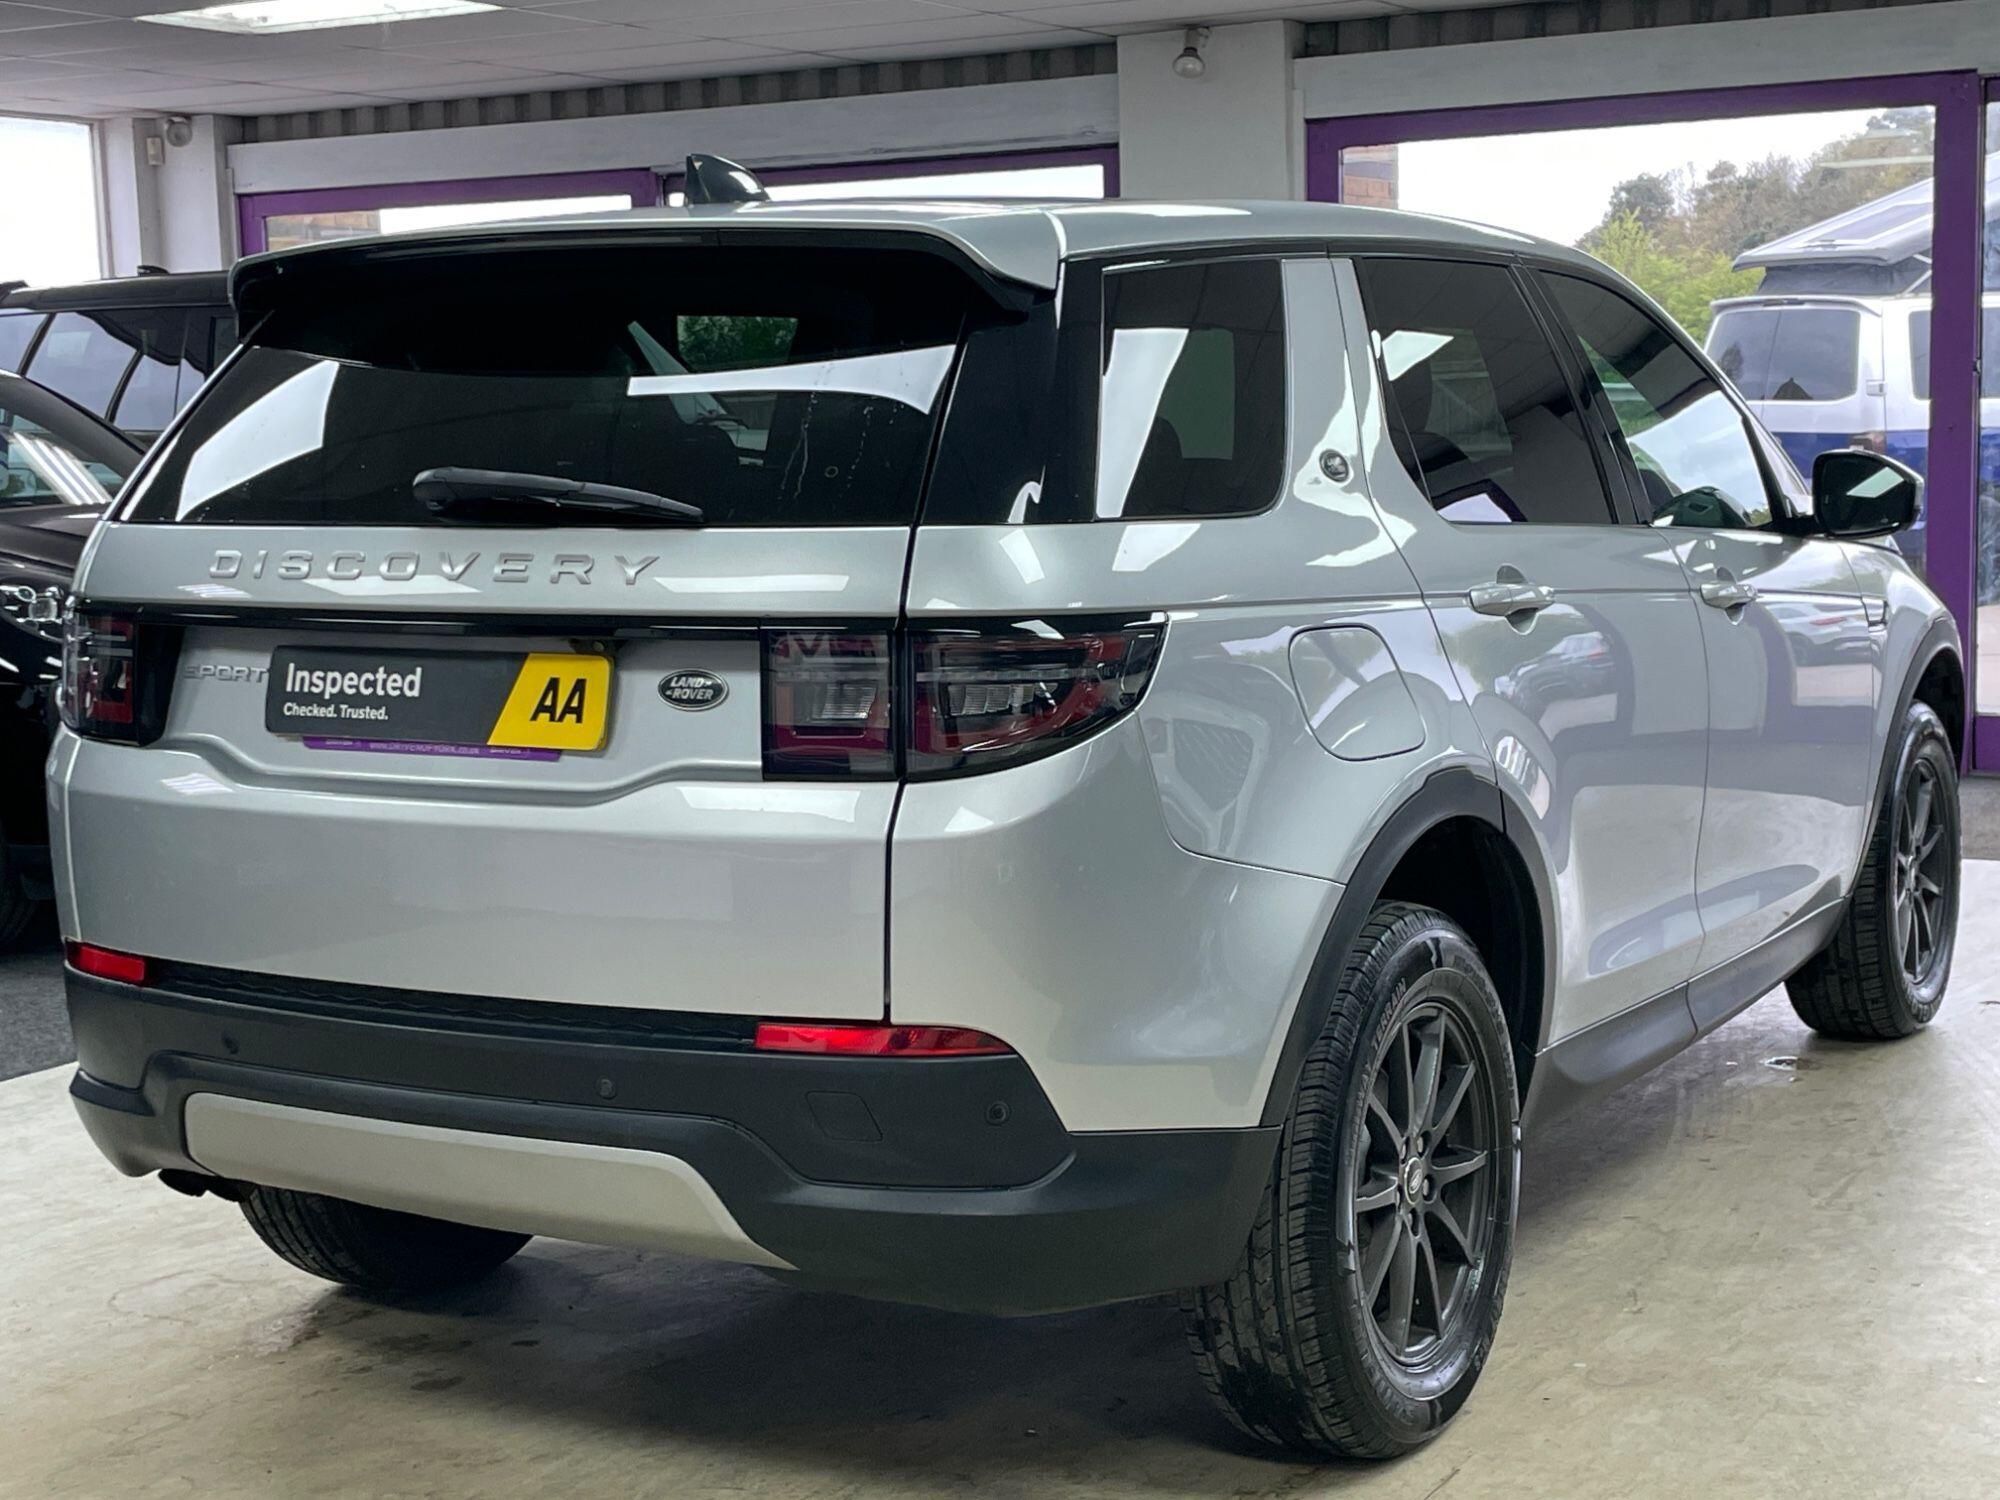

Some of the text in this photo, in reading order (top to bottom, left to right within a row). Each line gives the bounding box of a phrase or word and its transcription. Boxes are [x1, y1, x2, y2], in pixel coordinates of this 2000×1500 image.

[209, 549, 660, 585] DISCOVERY
[183, 664, 269, 683] SPORT
[285, 662, 423, 700] Inspected
[670, 676, 704, 688] LAND
[529, 677, 587, 724] AA
[671, 688, 714, 700] ROVER
[283, 701, 389, 720] Checked. Trusted.
[1373, 977, 1407, 1050] TERRAIN
